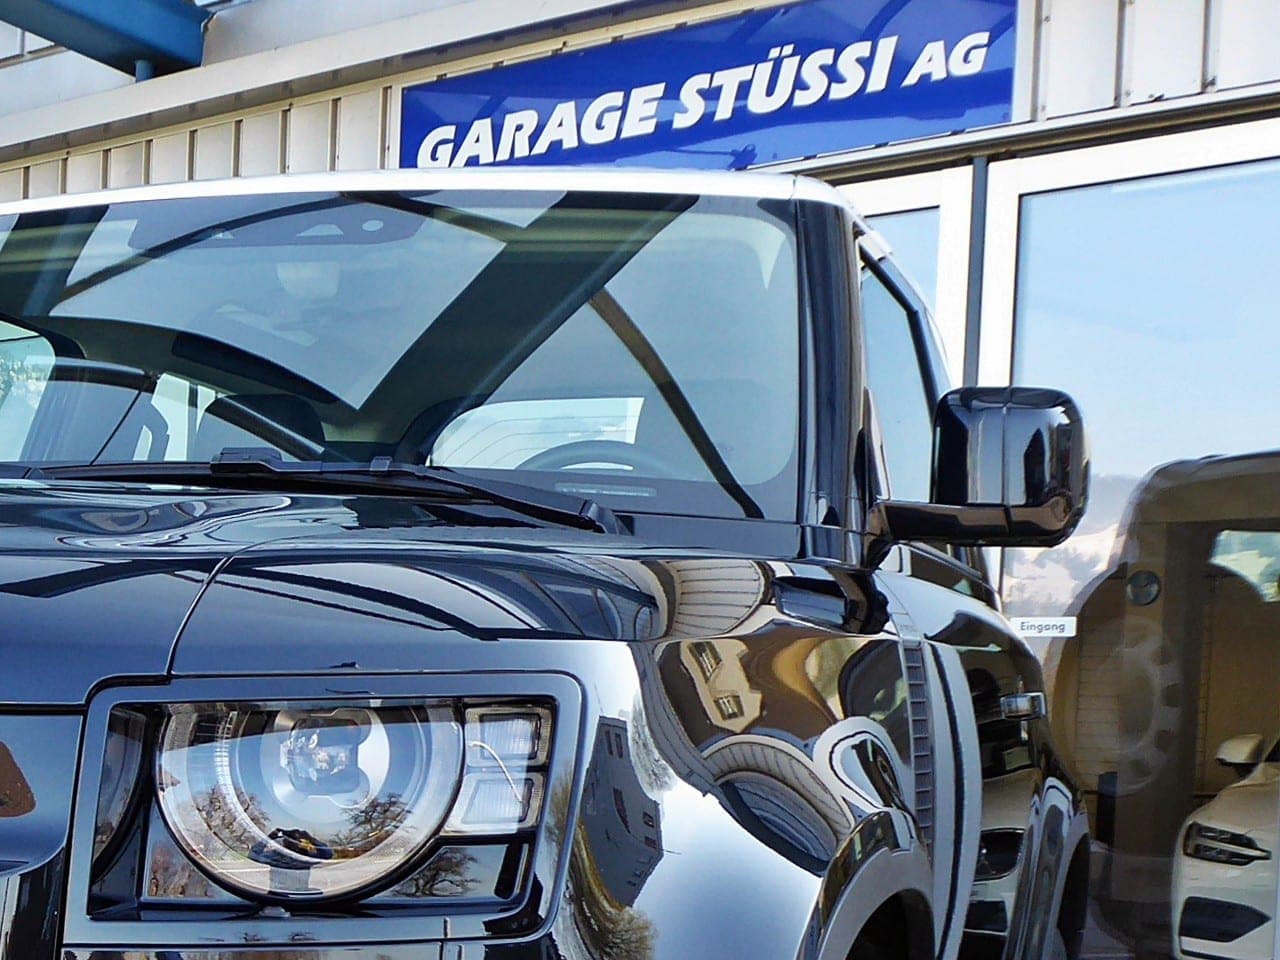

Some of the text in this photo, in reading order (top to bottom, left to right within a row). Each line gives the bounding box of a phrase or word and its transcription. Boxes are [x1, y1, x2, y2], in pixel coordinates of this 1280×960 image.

[416, 31, 990, 168] GARAGE STÜSSI AG
[1020, 621, 1066, 633] Eingang
